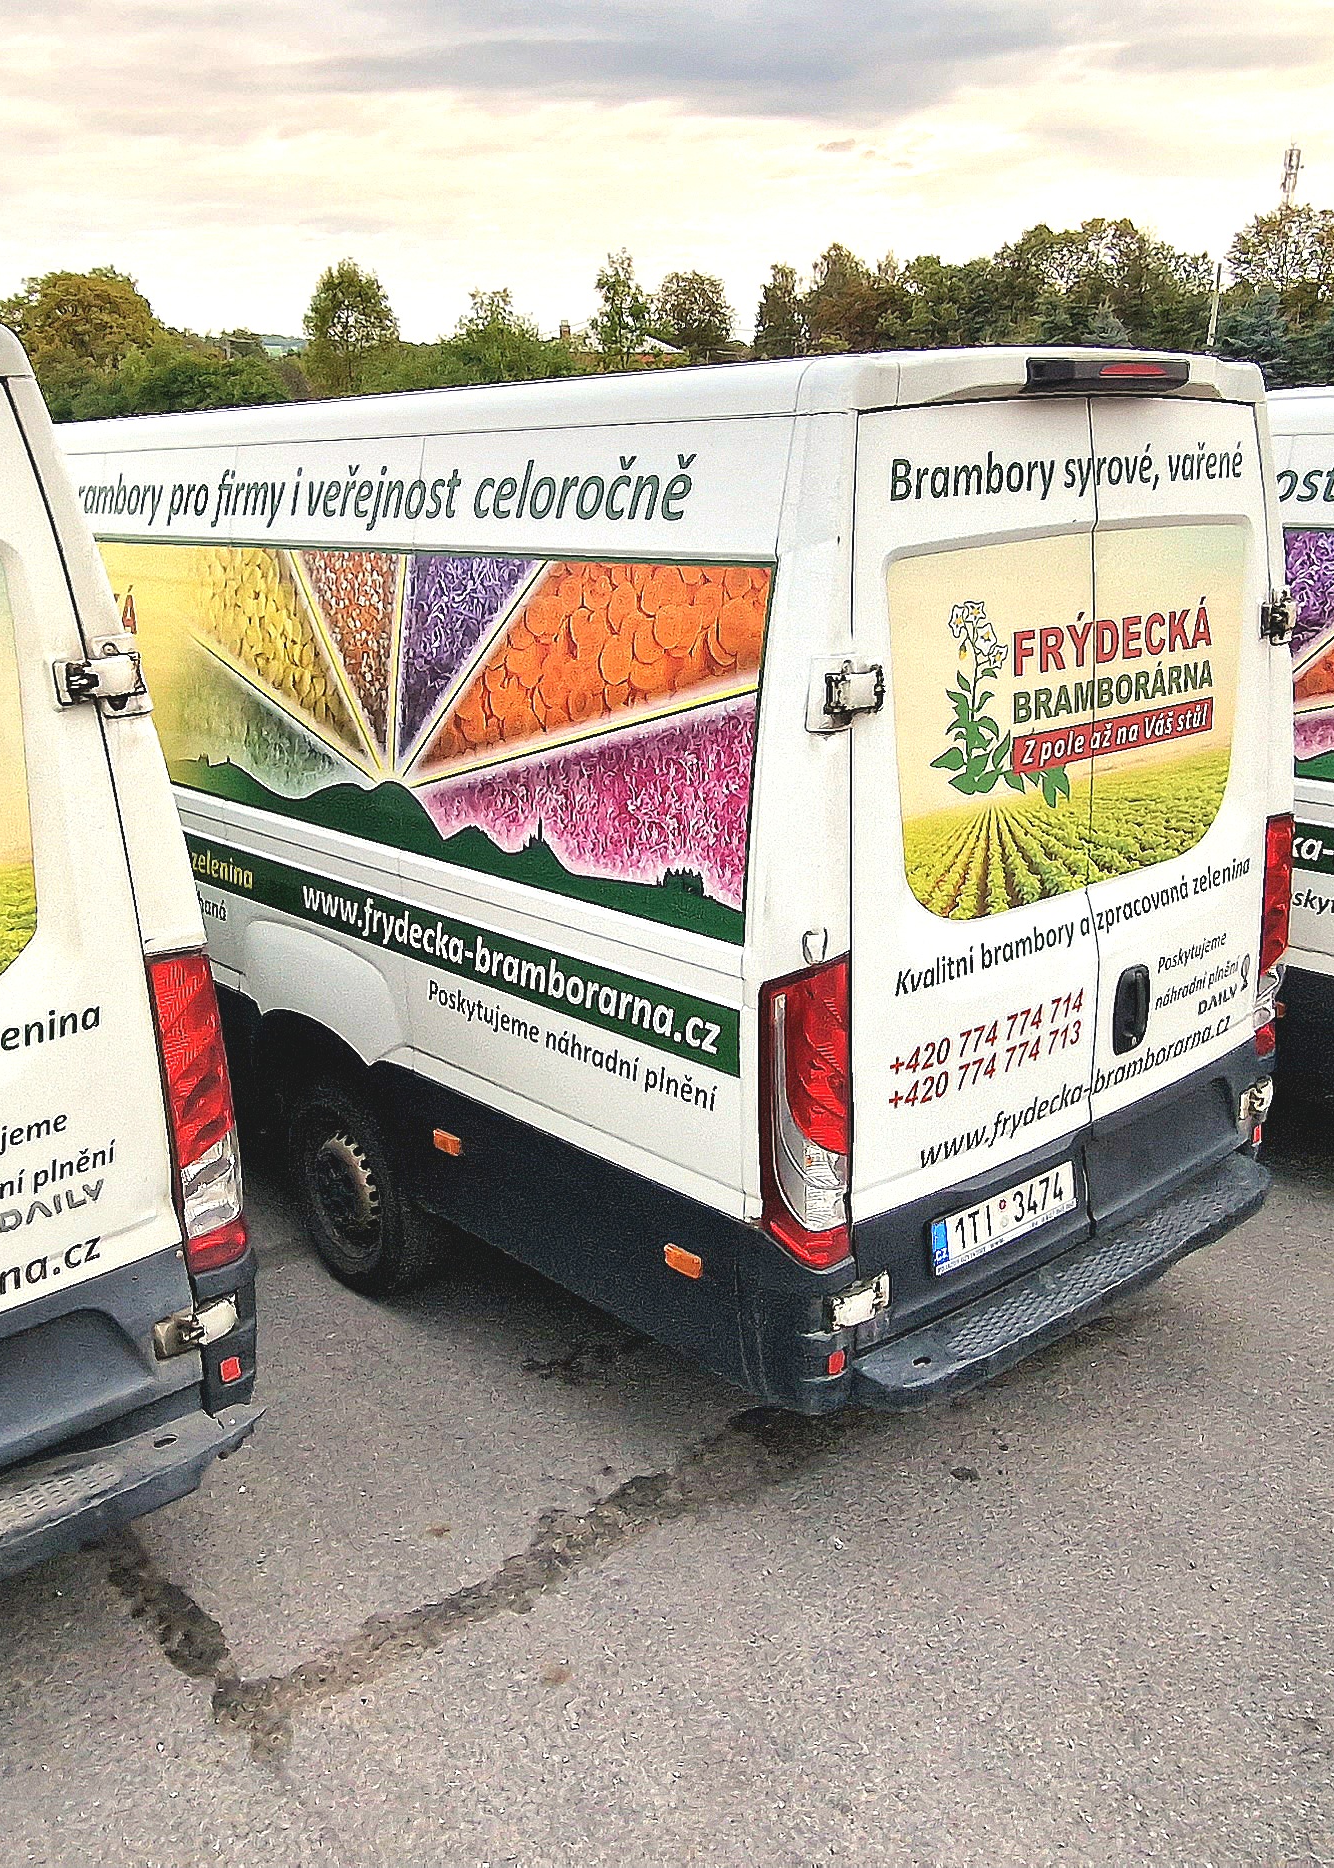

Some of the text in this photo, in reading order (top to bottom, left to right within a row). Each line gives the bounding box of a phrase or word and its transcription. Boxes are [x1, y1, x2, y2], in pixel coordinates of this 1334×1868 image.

[78, 453, 697, 531] ambory pro firmy i veřejnost celoročně
[890, 440, 1244, 502] Brambory syrové, vařené
[1012, 596, 1214, 678] FRÝDECKÁ
[1012, 659, 1215, 725] BRAMBORÁRNA
[1021, 702, 1209, 767] Z pole až na Váš stůl
[192, 848, 254, 890] zelenina
[894, 855, 1252, 998] Kvalitní brambory a zpracovaná zelenina
[1157, 932, 1227, 975] Poskytujeme
[301, 881, 722, 1056] www.frydecka-bramborarna.cz
[1154, 970, 1208, 1011] náhradní
[1197, 982, 1238, 1016] DAILY
[427, 979, 719, 1113] Poskytujeme náhradní plnění
[887, 1019, 1083, 1111] +420 774 774 713
[889, 986, 1086, 1076] +420 774 774 714
[918, 1014, 1232, 1170] www.frydecka-bramborarna.cz
[33, 1139, 117, 1199] plnění
[954, 1204, 993, 1250] 1TI
[1012, 1171, 1064, 1223] 3474
[934, 1246, 950, 1263] CZ
